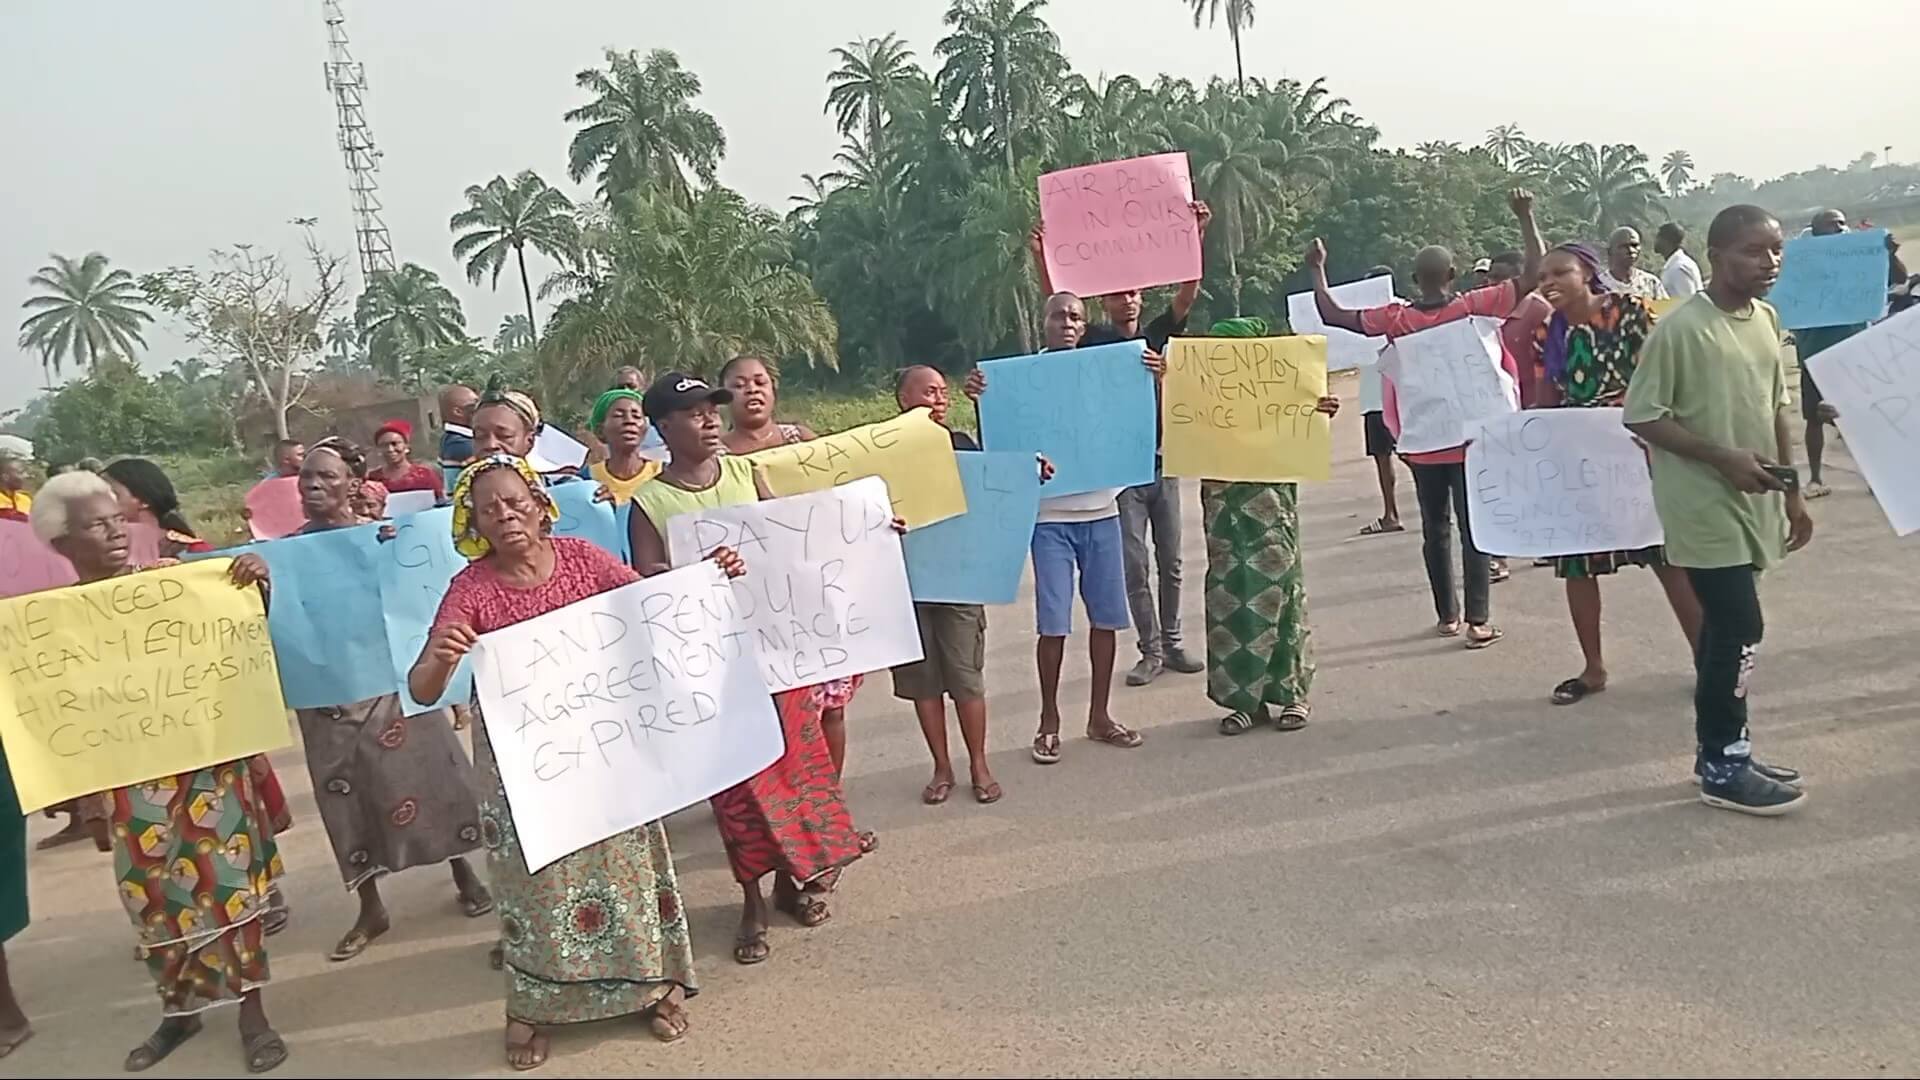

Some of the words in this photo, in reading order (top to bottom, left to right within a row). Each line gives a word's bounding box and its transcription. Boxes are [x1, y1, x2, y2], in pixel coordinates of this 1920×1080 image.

[1046, 171, 1103, 204] AIR
[1081, 207, 1113, 231] IN
[1122, 196, 1189, 228] OUR
[1054, 224, 1196, 267] COMMUNITY
[1170, 403, 1239, 429] SINCE
[1256, 403, 1317, 440] 1999
[1480, 416, 1550, 459] NO
[1, 599, 51, 650] WE
[80, 579, 184, 625] NEED
[9, 628, 131, 686] HEAVY
[491, 611, 628, 698] LAND
[48, 696, 223, 757] CONTRACTS
[533, 690, 718, 782] EXPIRED
